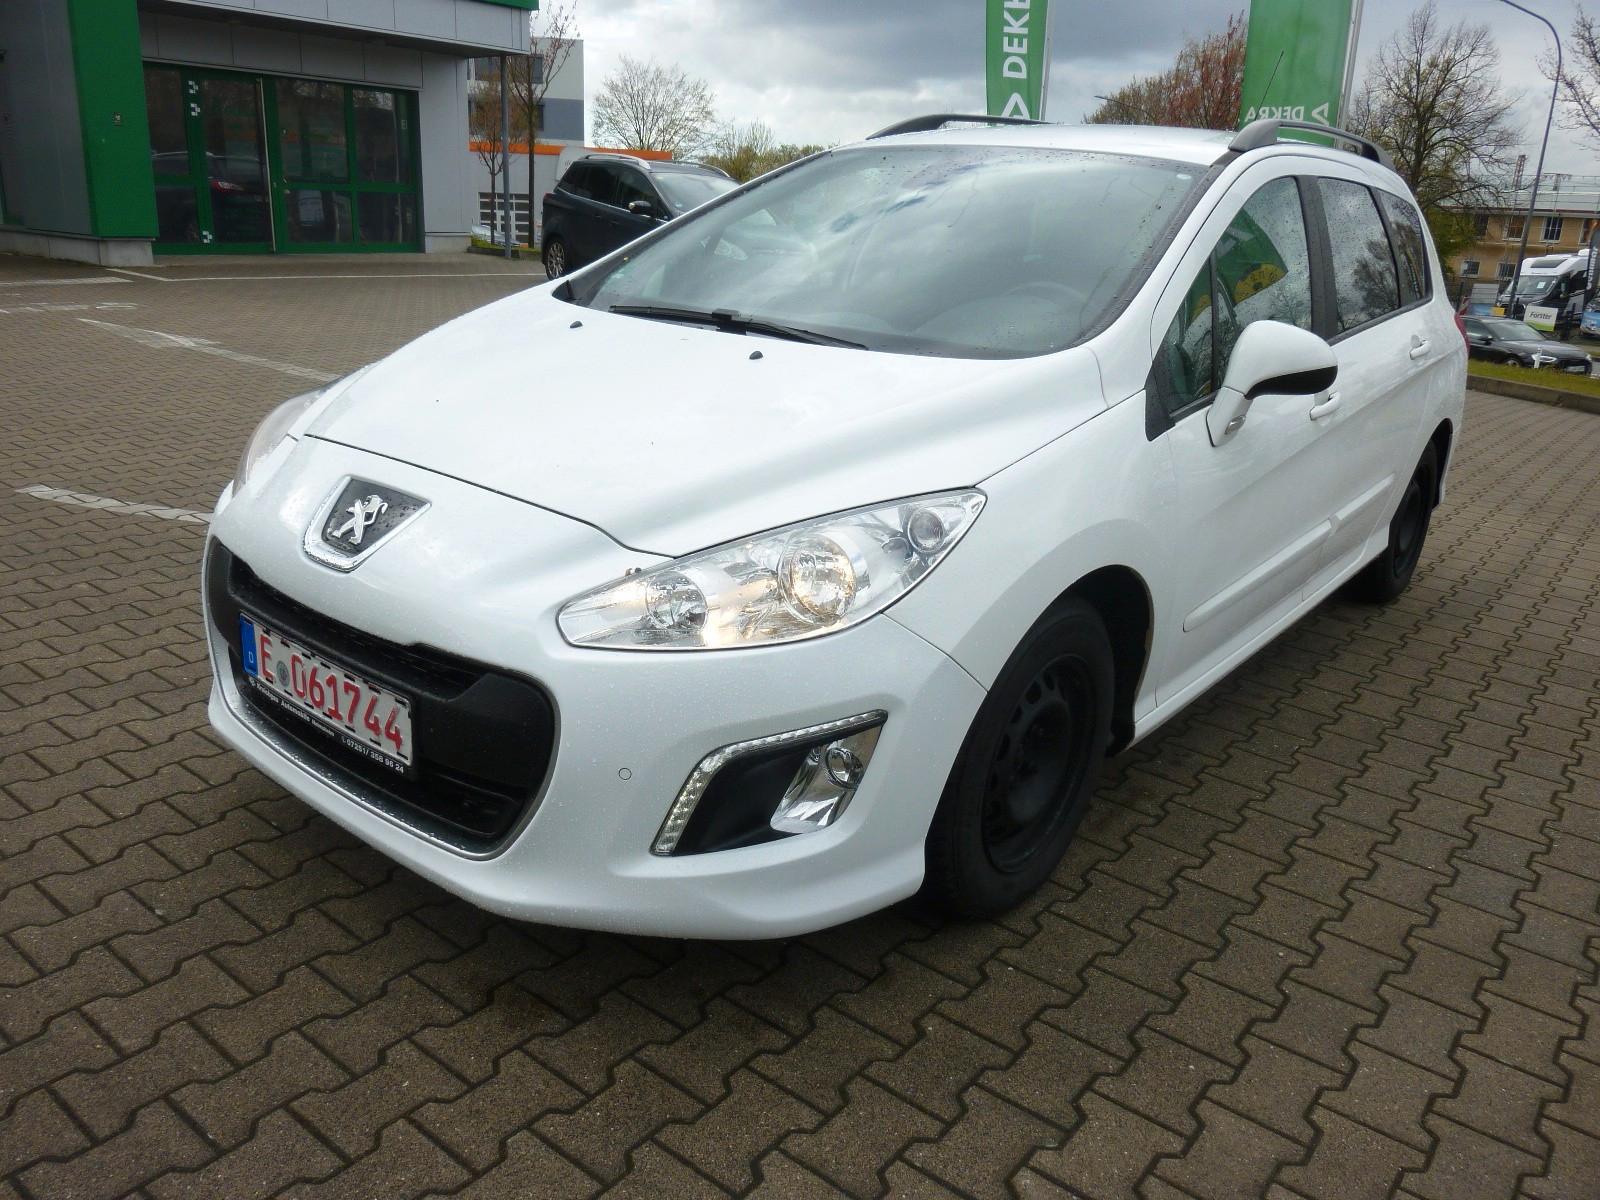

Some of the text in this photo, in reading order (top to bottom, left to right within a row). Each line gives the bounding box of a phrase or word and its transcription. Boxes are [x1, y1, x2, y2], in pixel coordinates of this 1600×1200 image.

[259, 633, 403, 751] E 061744
[394, 763, 405, 775] 24
